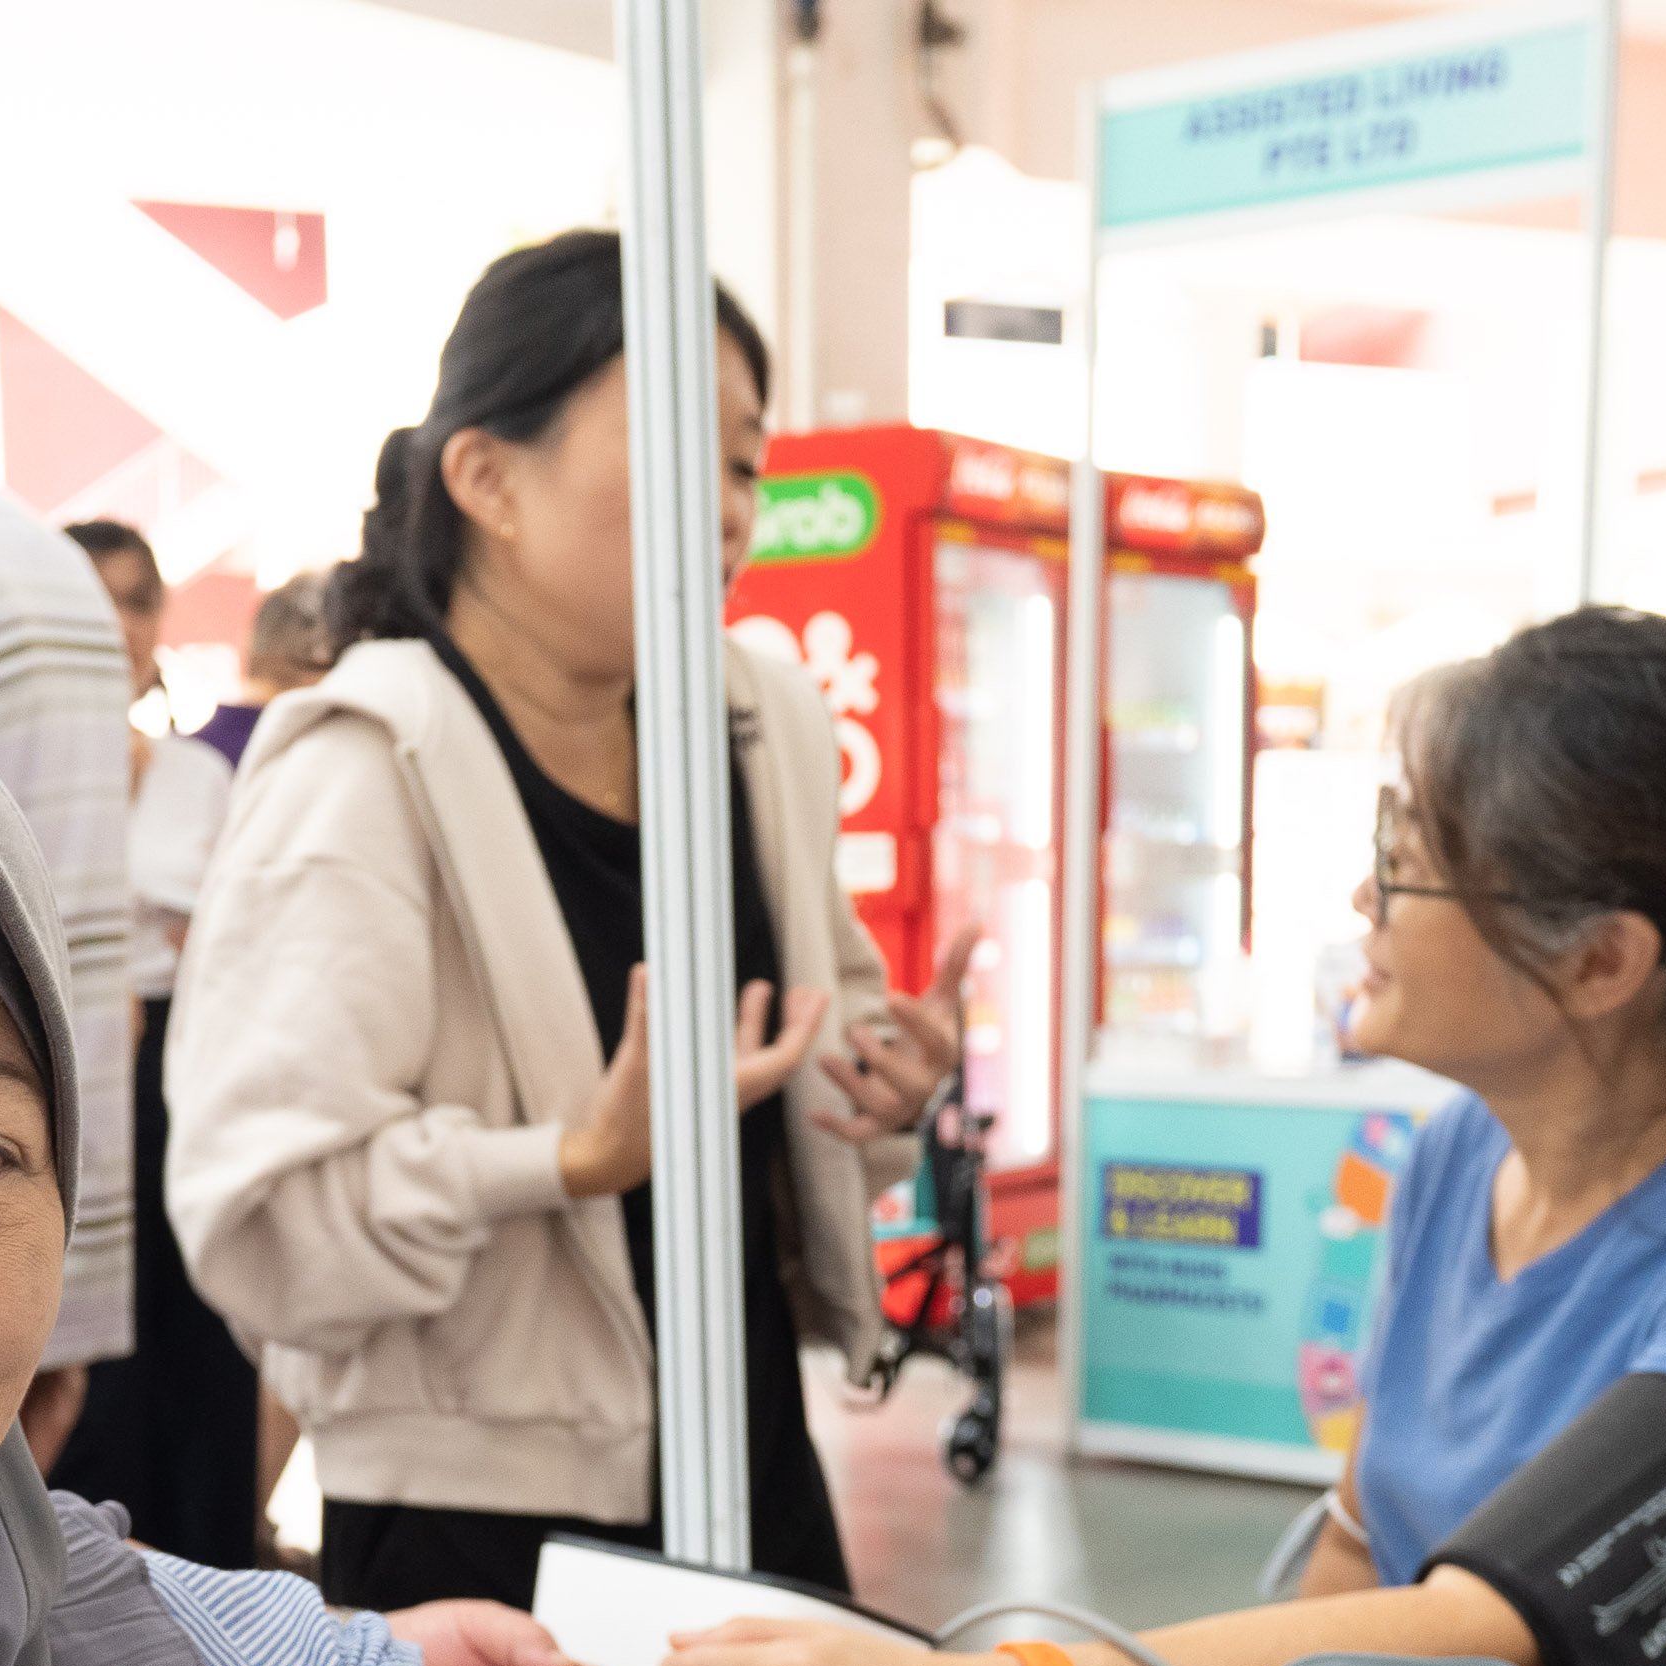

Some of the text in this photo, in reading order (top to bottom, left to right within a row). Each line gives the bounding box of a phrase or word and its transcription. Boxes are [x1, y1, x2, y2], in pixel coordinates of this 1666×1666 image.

[1184, 48, 1509, 141] ASSISTED LIVING
[1261, 117, 1416, 175] PTE LTD
[1137, 1213, 1235, 1242] LEARN
